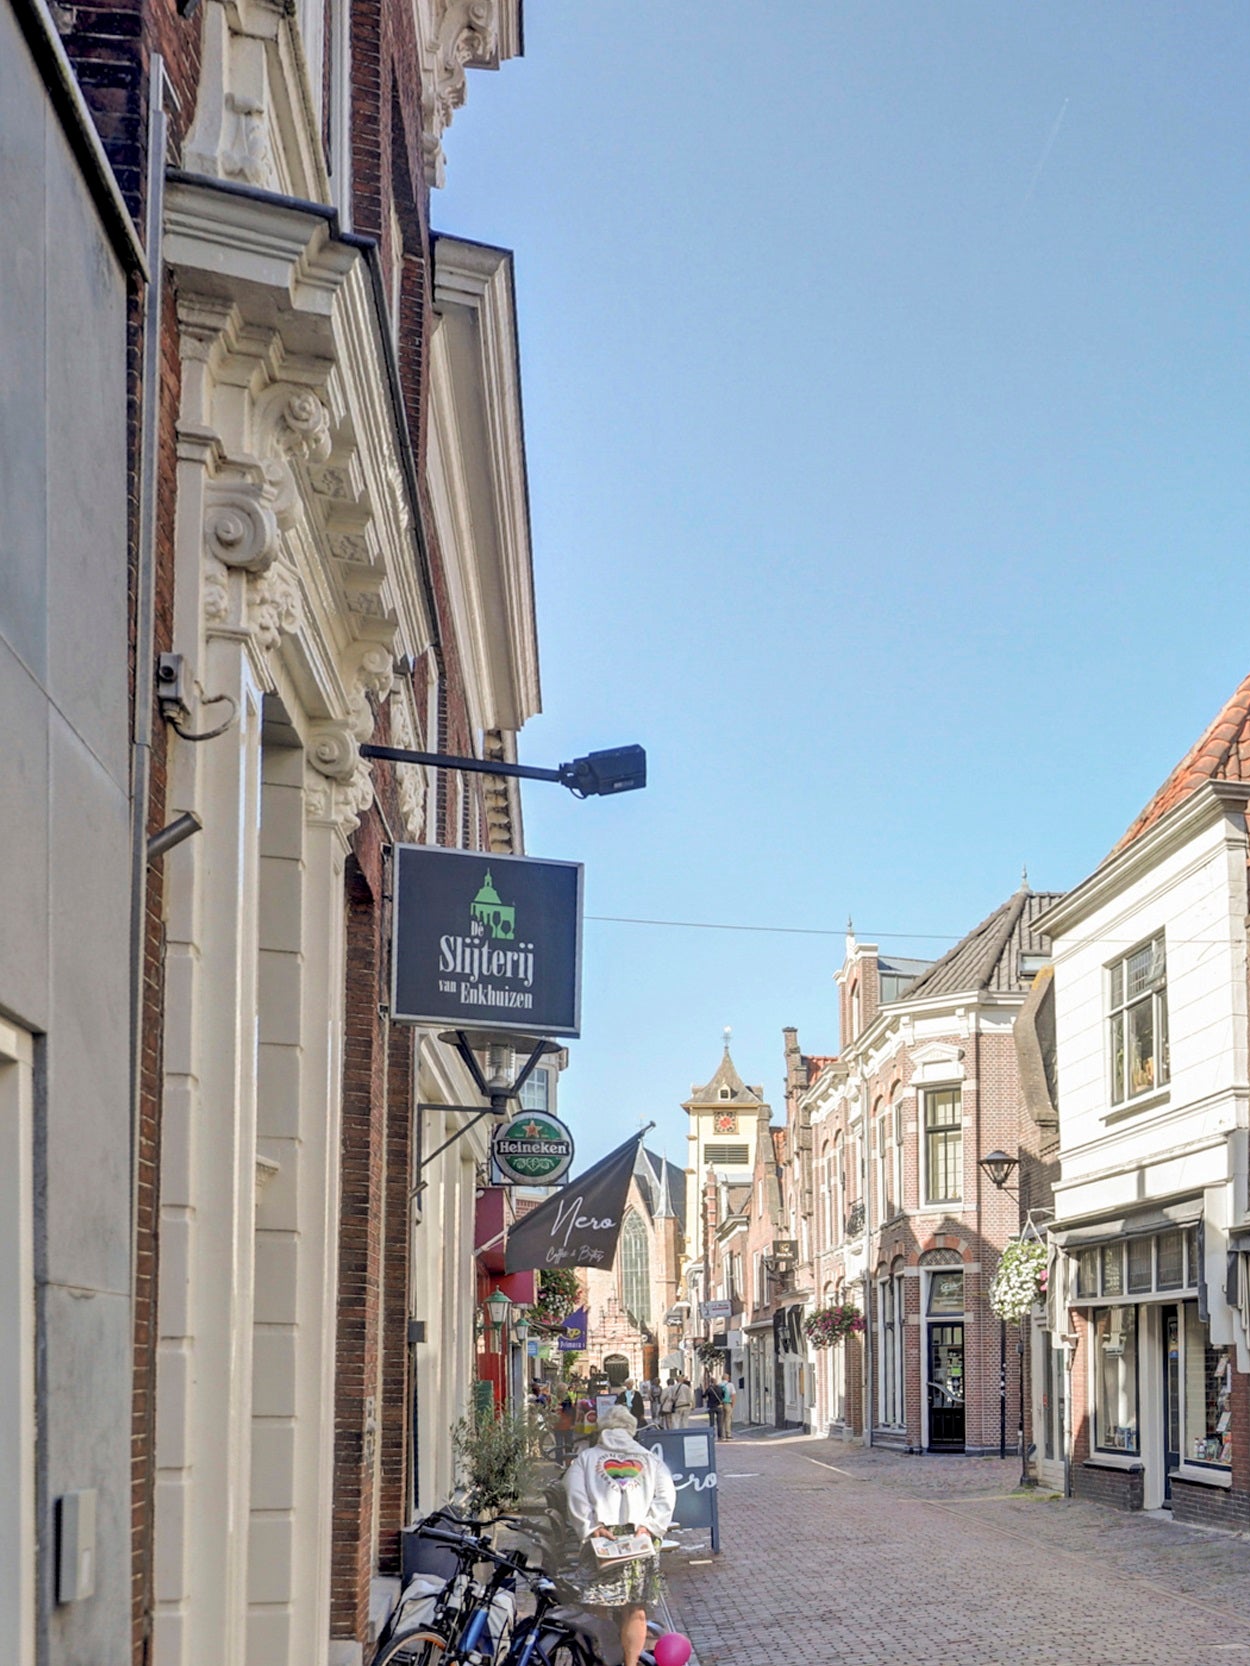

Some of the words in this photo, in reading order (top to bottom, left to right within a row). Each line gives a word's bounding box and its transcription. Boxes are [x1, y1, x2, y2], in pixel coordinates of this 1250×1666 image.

[470, 920, 485, 937] Dé
[439, 935, 535, 988] Slijterij
[439, 980, 457, 993] van
[460, 982, 533, 1009] Enkhuizen
[500, 1141, 567, 1155] Heineken
[550, 1196, 616, 1247] Nero
